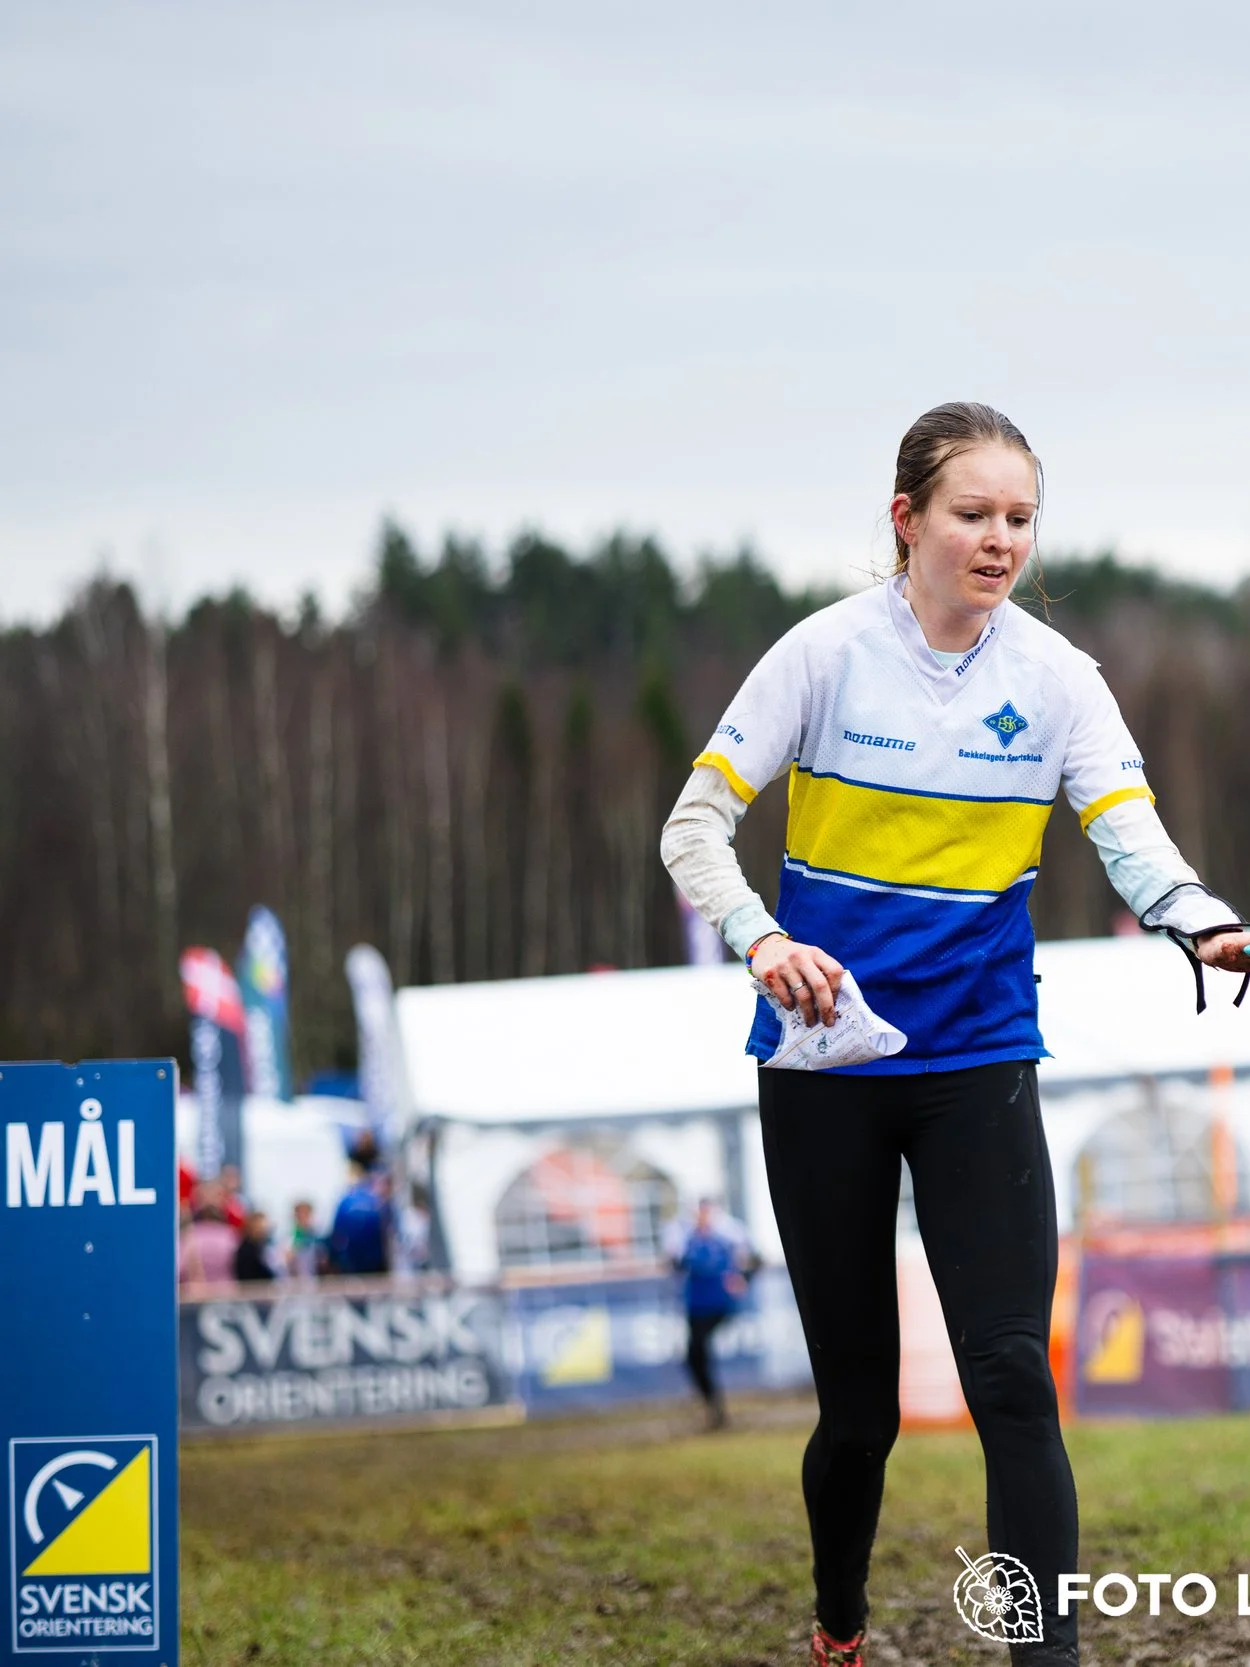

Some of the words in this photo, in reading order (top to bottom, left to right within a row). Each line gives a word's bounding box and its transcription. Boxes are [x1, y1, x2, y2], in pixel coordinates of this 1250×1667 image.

[843, 730, 917, 751] noname
[1007, 753, 1043, 764] Sportsklub
[6, 1098, 156, 1207] MÅL
[199, 1298, 479, 1376] SVENSK
[199, 1354, 488, 1425] ORIENTERING
[20, 1582, 152, 1615] SVENSK
[19, 1615, 154, 1638] ORIENTERING
